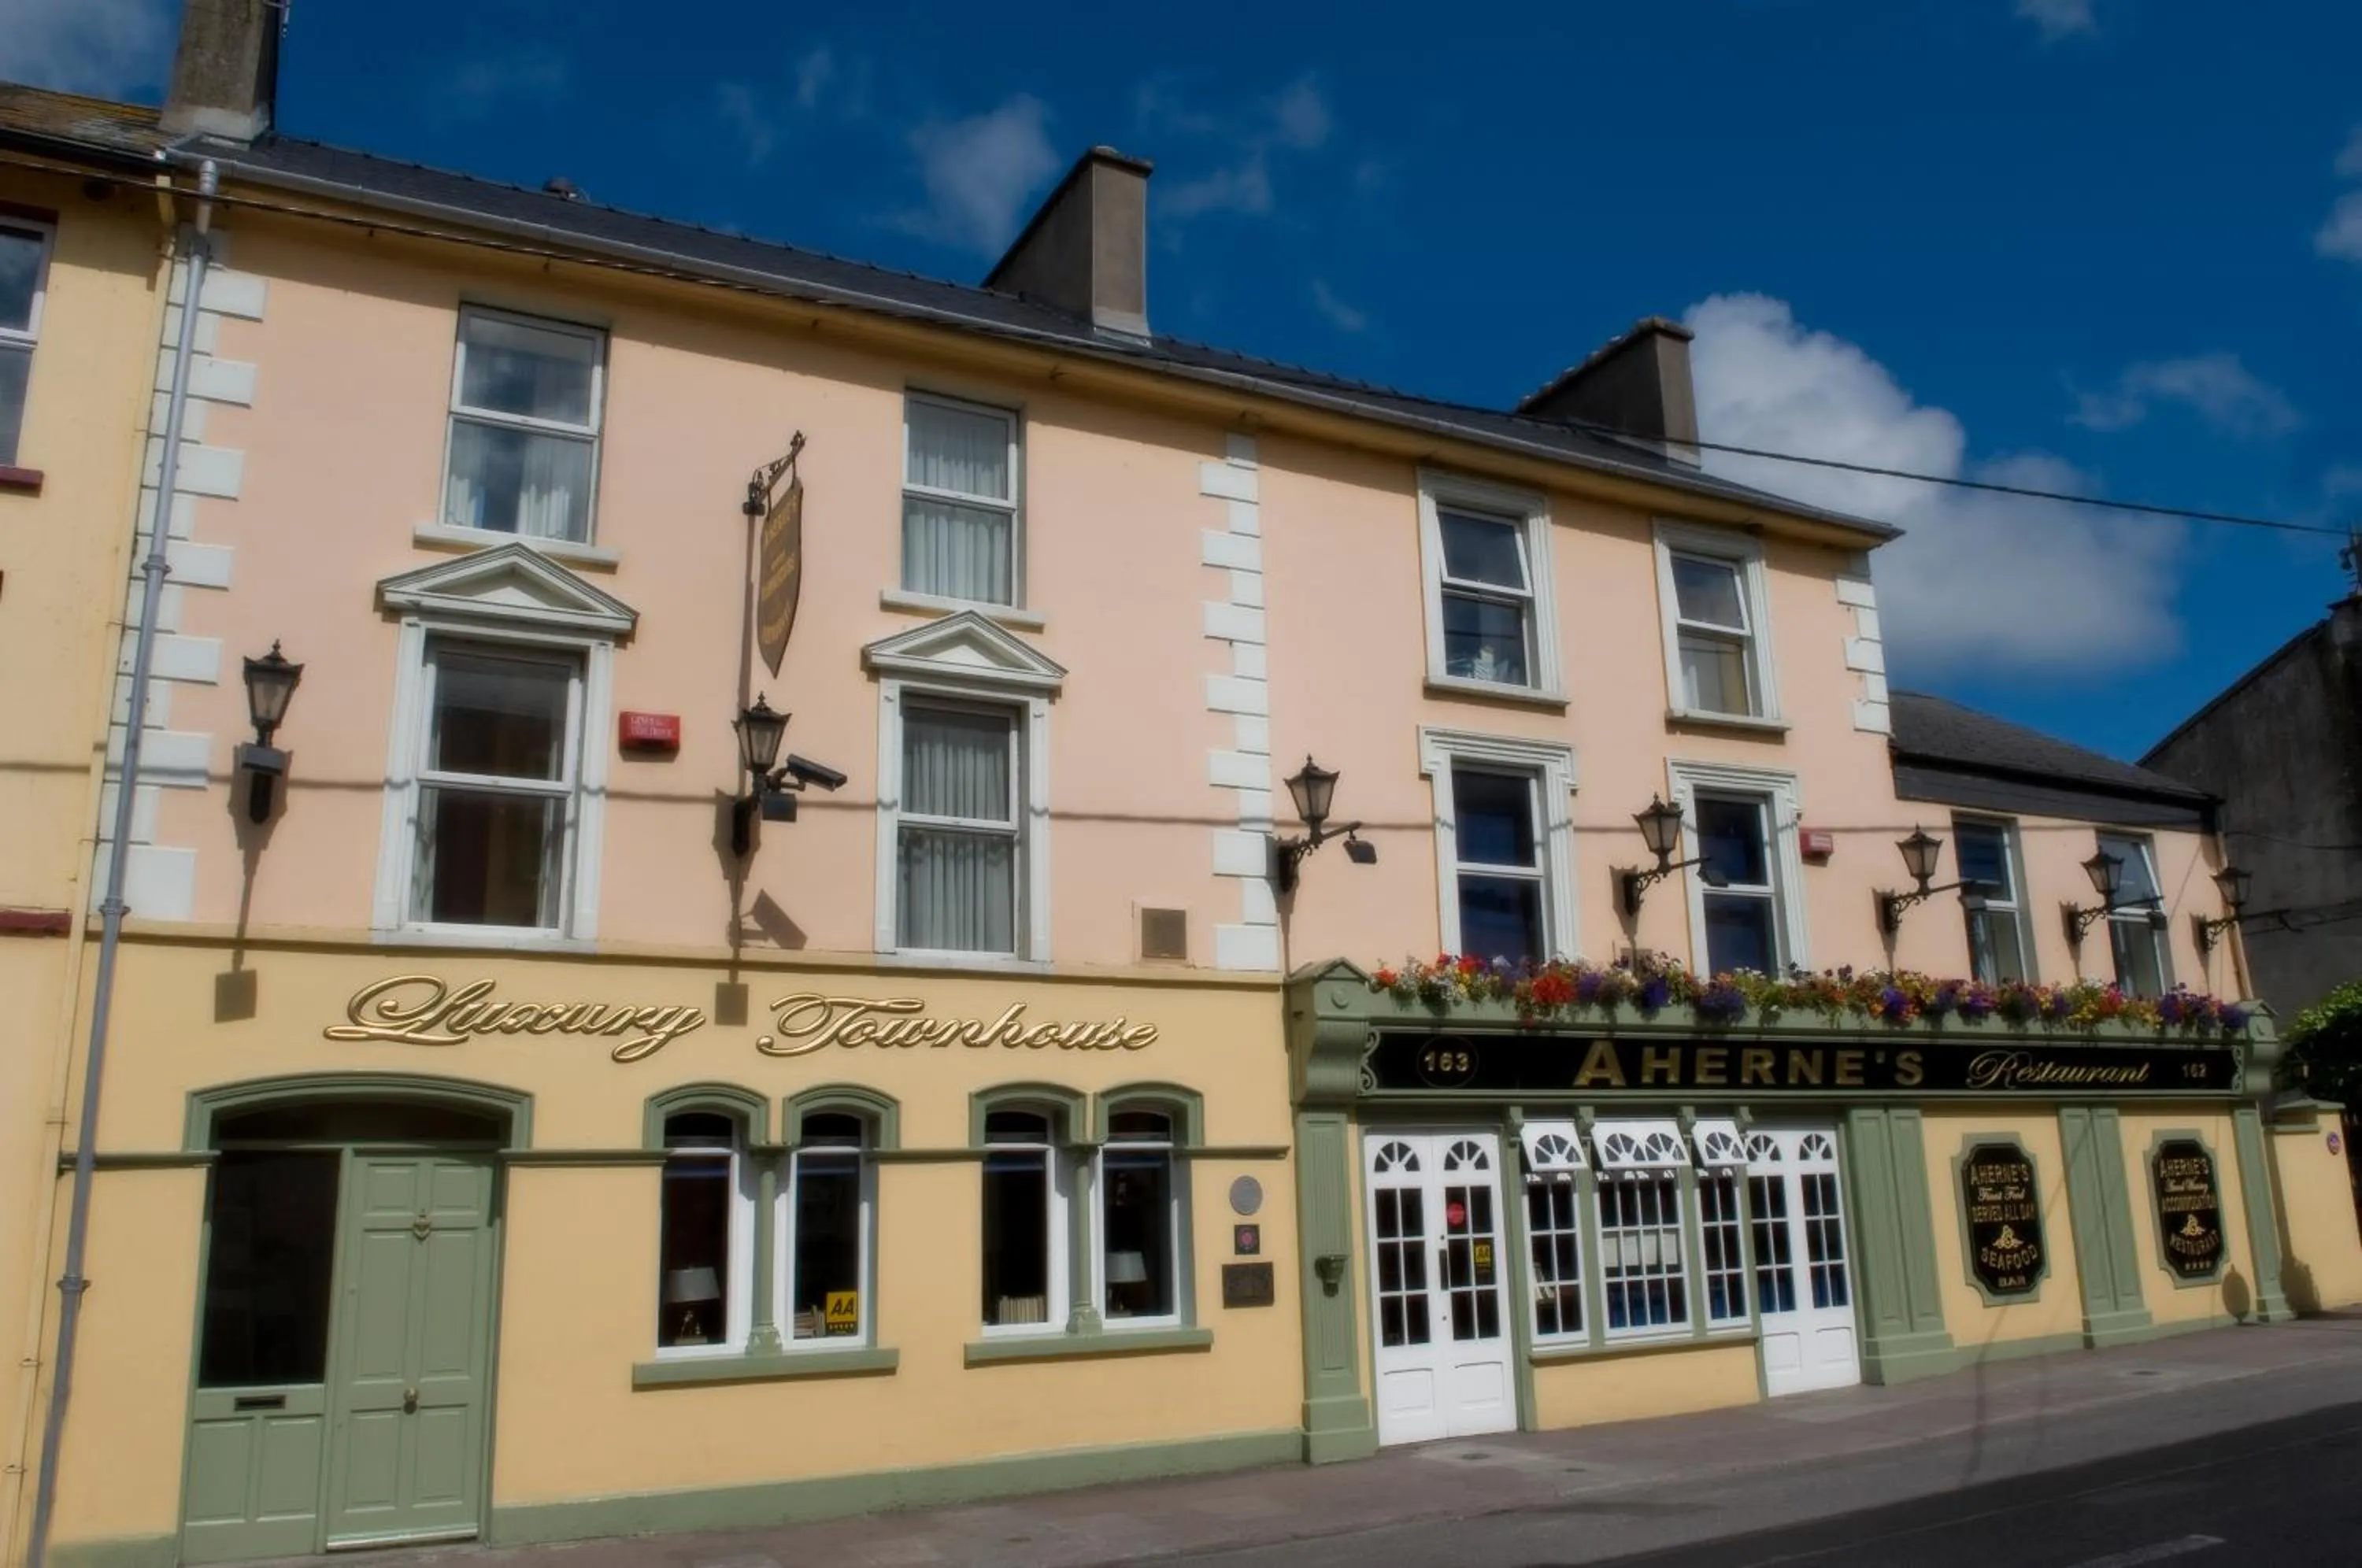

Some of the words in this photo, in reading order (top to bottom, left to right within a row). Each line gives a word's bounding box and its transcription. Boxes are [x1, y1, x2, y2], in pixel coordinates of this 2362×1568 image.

[323, 974, 706, 1063] Luxury
[756, 992, 1160, 1058] Townhouse
[1423, 1051, 1470, 1072] 163
[1572, 1040, 1924, 1086] AHERNE'S
[1966, 1050, 2153, 1089] Restaurant
[1970, 1163, 2029, 1185] AHERNE'S
[1981, 1244, 2038, 1270] SEAFOOD
[1998, 1275, 2027, 1287] BAR
[831, 1296, 854, 1316] AA
